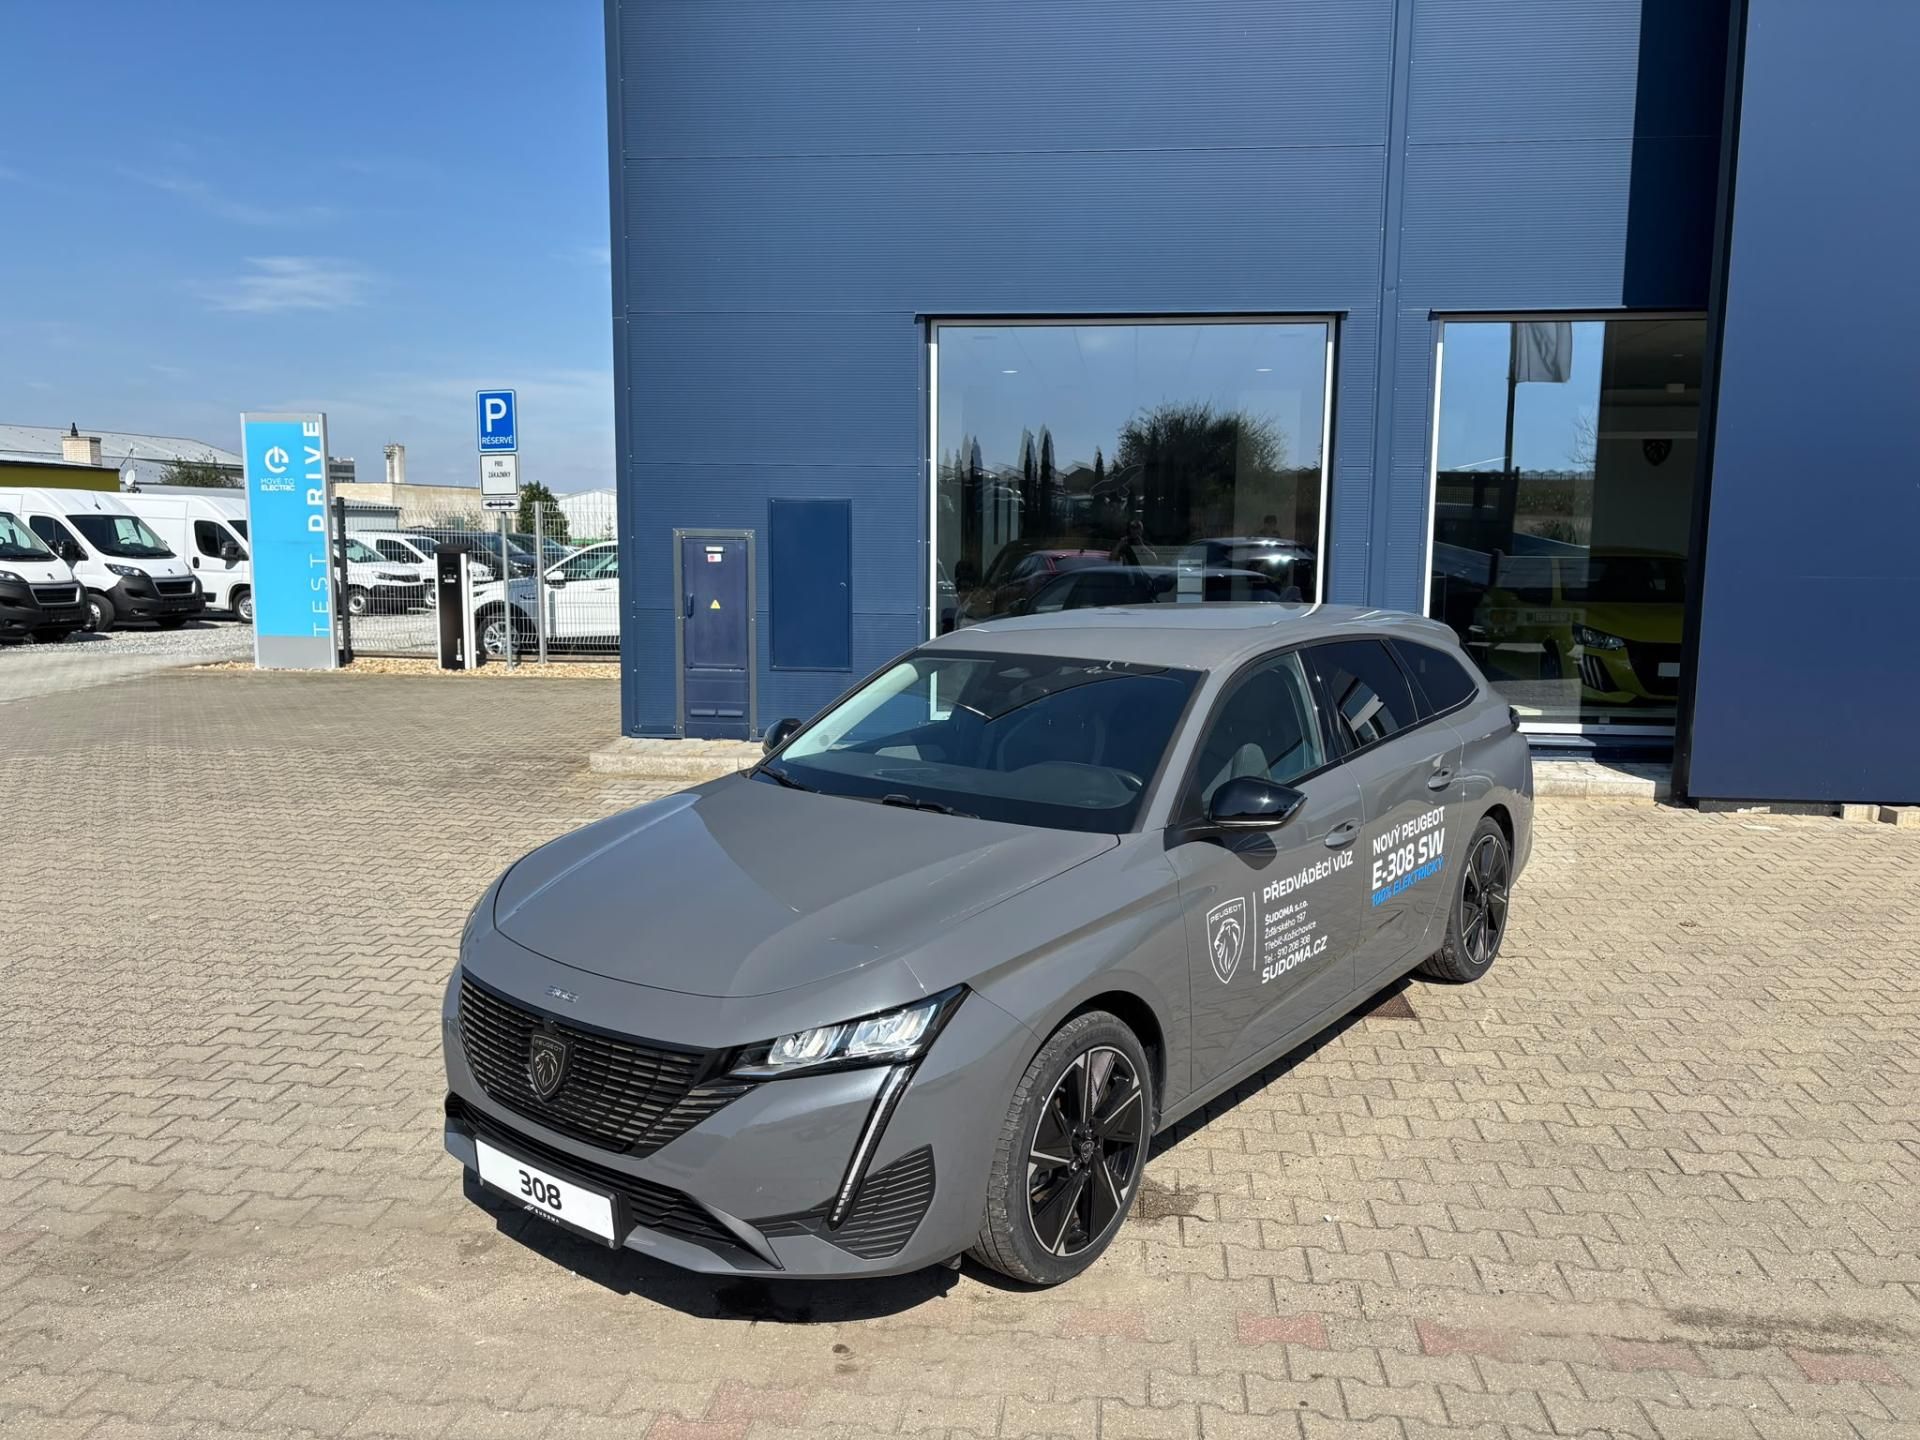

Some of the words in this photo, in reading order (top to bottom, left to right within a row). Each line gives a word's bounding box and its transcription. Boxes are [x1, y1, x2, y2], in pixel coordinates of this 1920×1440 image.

[485, 398, 507, 432] P
[481, 434, 513, 445] RÉSERVÉ
[303, 421, 325, 532] DRIVE
[310, 553, 330, 637] TEST
[1373, 824, 1400, 856] NOVÝ
[1402, 806, 1445, 840] PEUGEOT
[1263, 856, 1332, 904] PŘEDVÁDĚCÍ
[1332, 850, 1354, 873] VŮZ
[1372, 843, 1414, 890] E-308
[1418, 828, 1445, 864] SW
[1372, 884, 1392, 907] 100%
[1393, 854, 1444, 896] ELEKTRICKÝ
[1210, 903, 1242, 924] PEUGEOT
[1294, 900, 1309, 912] s.r.o.
[1296, 911, 1307, 922] 197
[1262, 935, 1328, 984] SUDOMA.CZ
[1277, 946, 1287, 958] 910
[1288, 940, 1299, 953] 208
[1300, 934, 1311, 947] 308
[518, 1169, 562, 1210] 308
